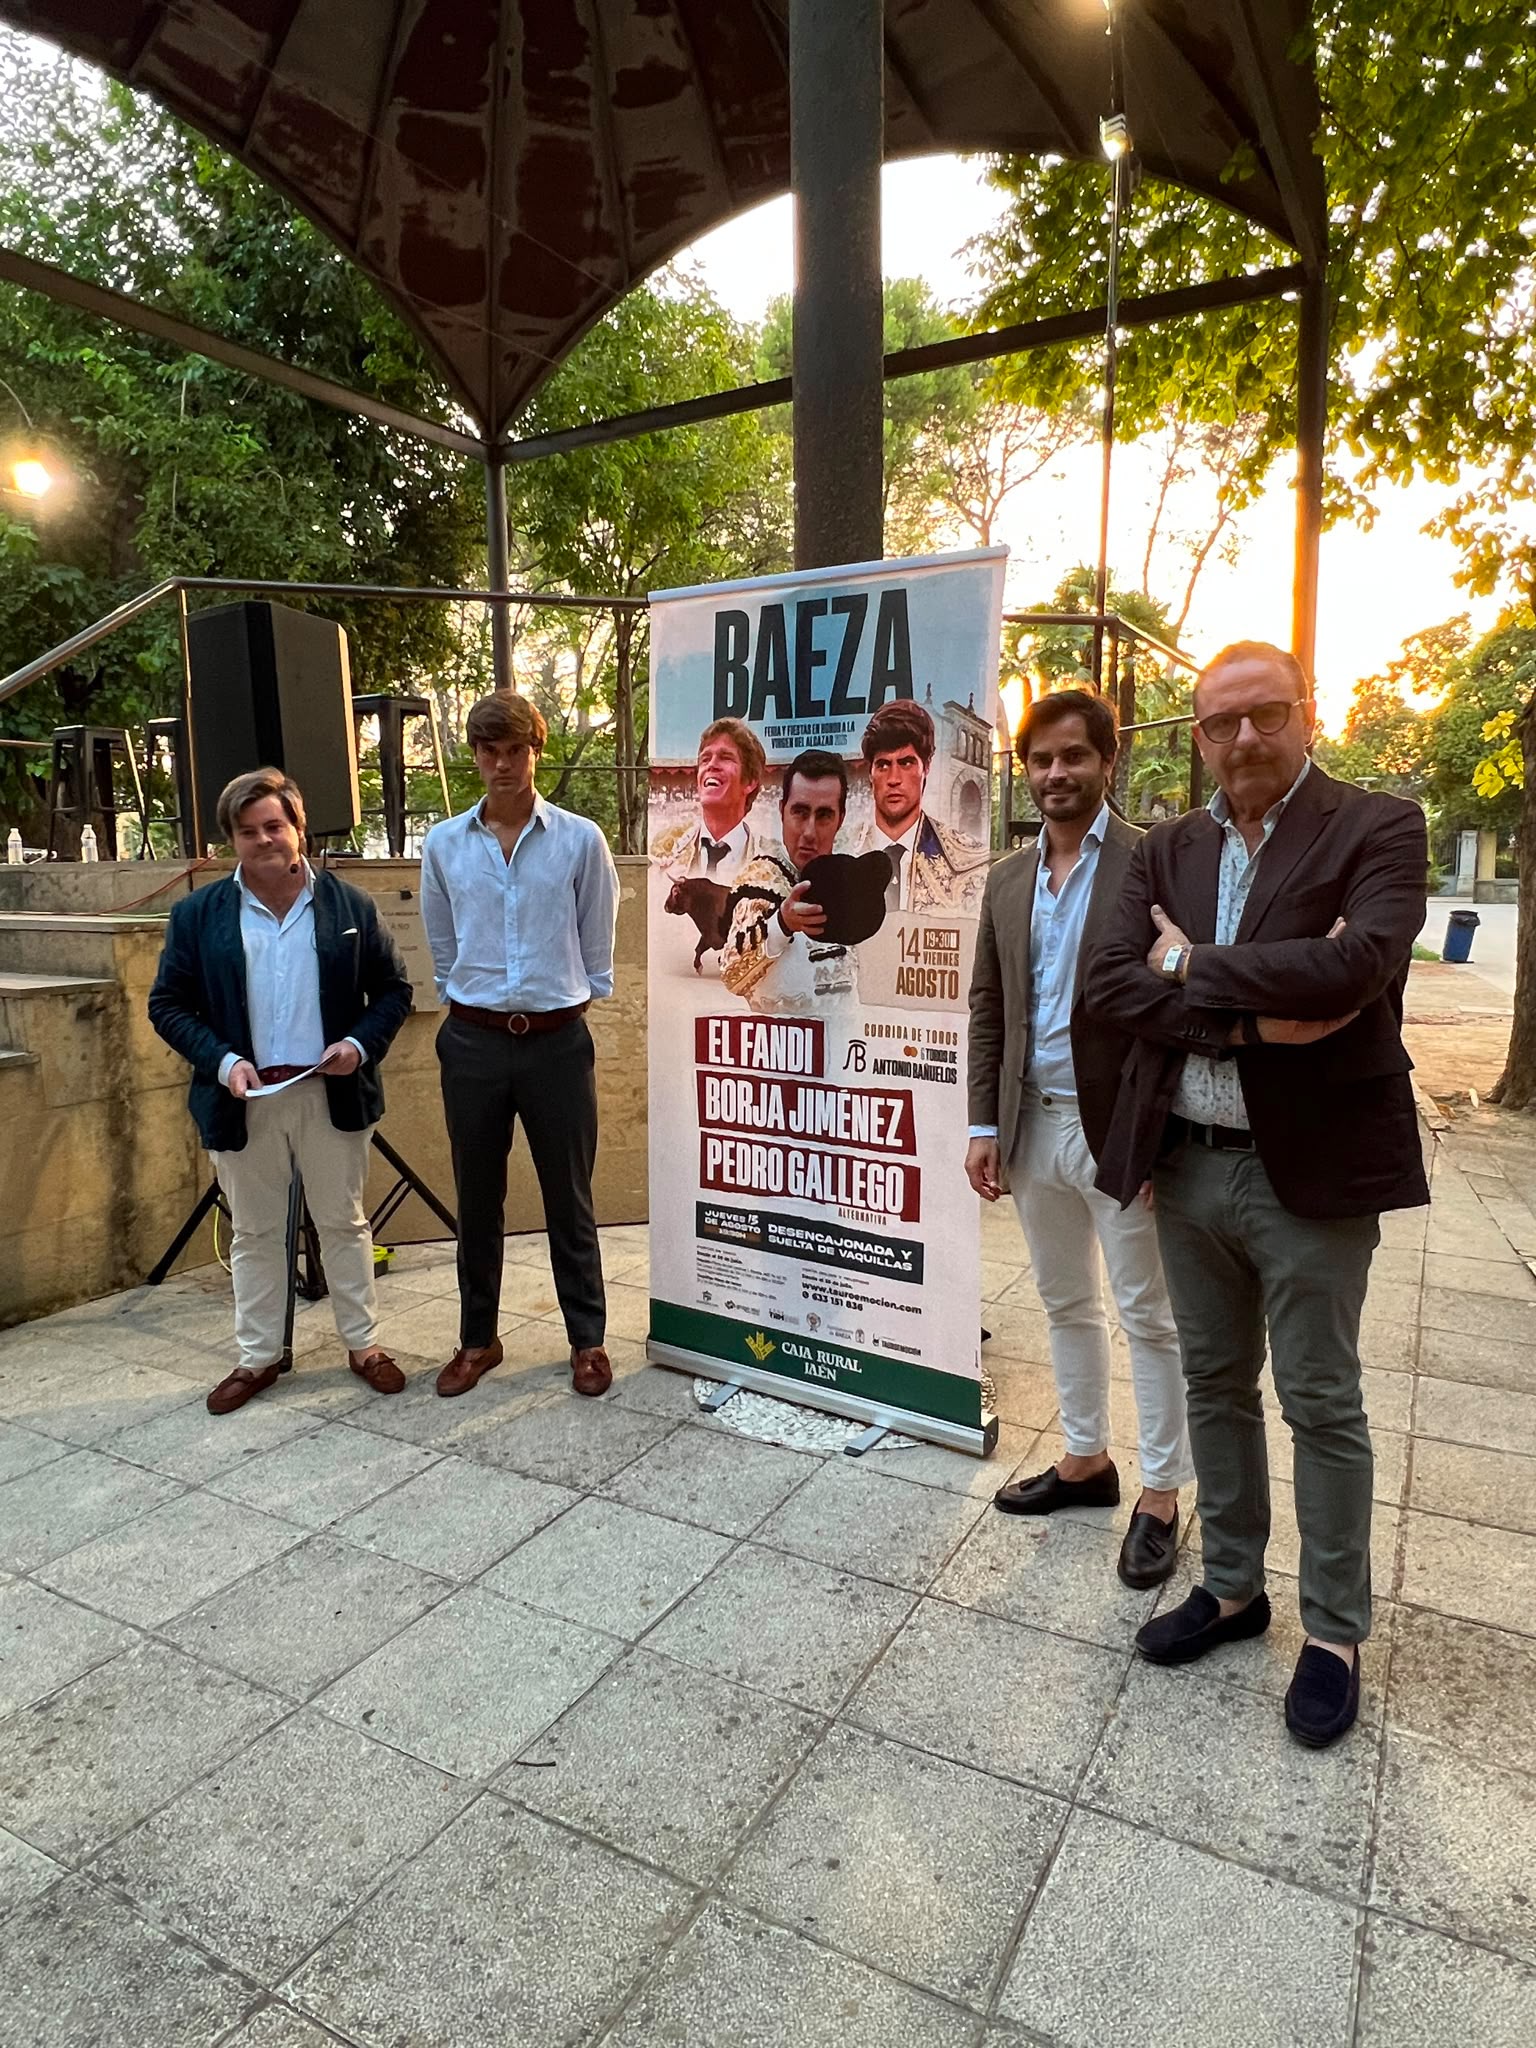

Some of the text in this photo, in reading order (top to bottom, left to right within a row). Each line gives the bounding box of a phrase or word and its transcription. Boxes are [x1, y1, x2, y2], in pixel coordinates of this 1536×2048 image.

[713, 588, 913, 722] BAEZA
[782, 724, 787, 737] Y
[787, 723, 812, 737] FIESTAS
[847, 720, 855, 733] LA
[897, 926, 921, 964] 14
[923, 951, 960, 967] VIERNES
[896, 966, 959, 1000] AGOSTO
[708, 1018, 814, 1074] EL FANDI
[864, 1022, 958, 1046] CORRIDA DE TOROS
[872, 1058, 958, 1085] ANTONIO BAÑUELOS
[949, 1051, 958, 1064] DE
[705, 1076, 904, 1148] BORJA JIMÉNEZ
[707, 1138, 904, 1214] PEDRO GALLEGO
[705, 1210, 746, 1223] JUEVES
[705, 1216, 761, 1234] DE AGOSTO
[838, 1207, 887, 1226] ALTERNATIVA
[768, 1223, 913, 1261] DESENCAJONADA Y
[768, 1234, 913, 1272] SUELTA DE VAQUILLAS
[801, 1282, 922, 1315] www.tauroemocion.com
[811, 1292, 829, 1303] 633
[831, 1296, 844, 1307] 151
[781, 1341, 862, 1374] CAJA RURAL
[804, 1361, 837, 1382] JAÉN
